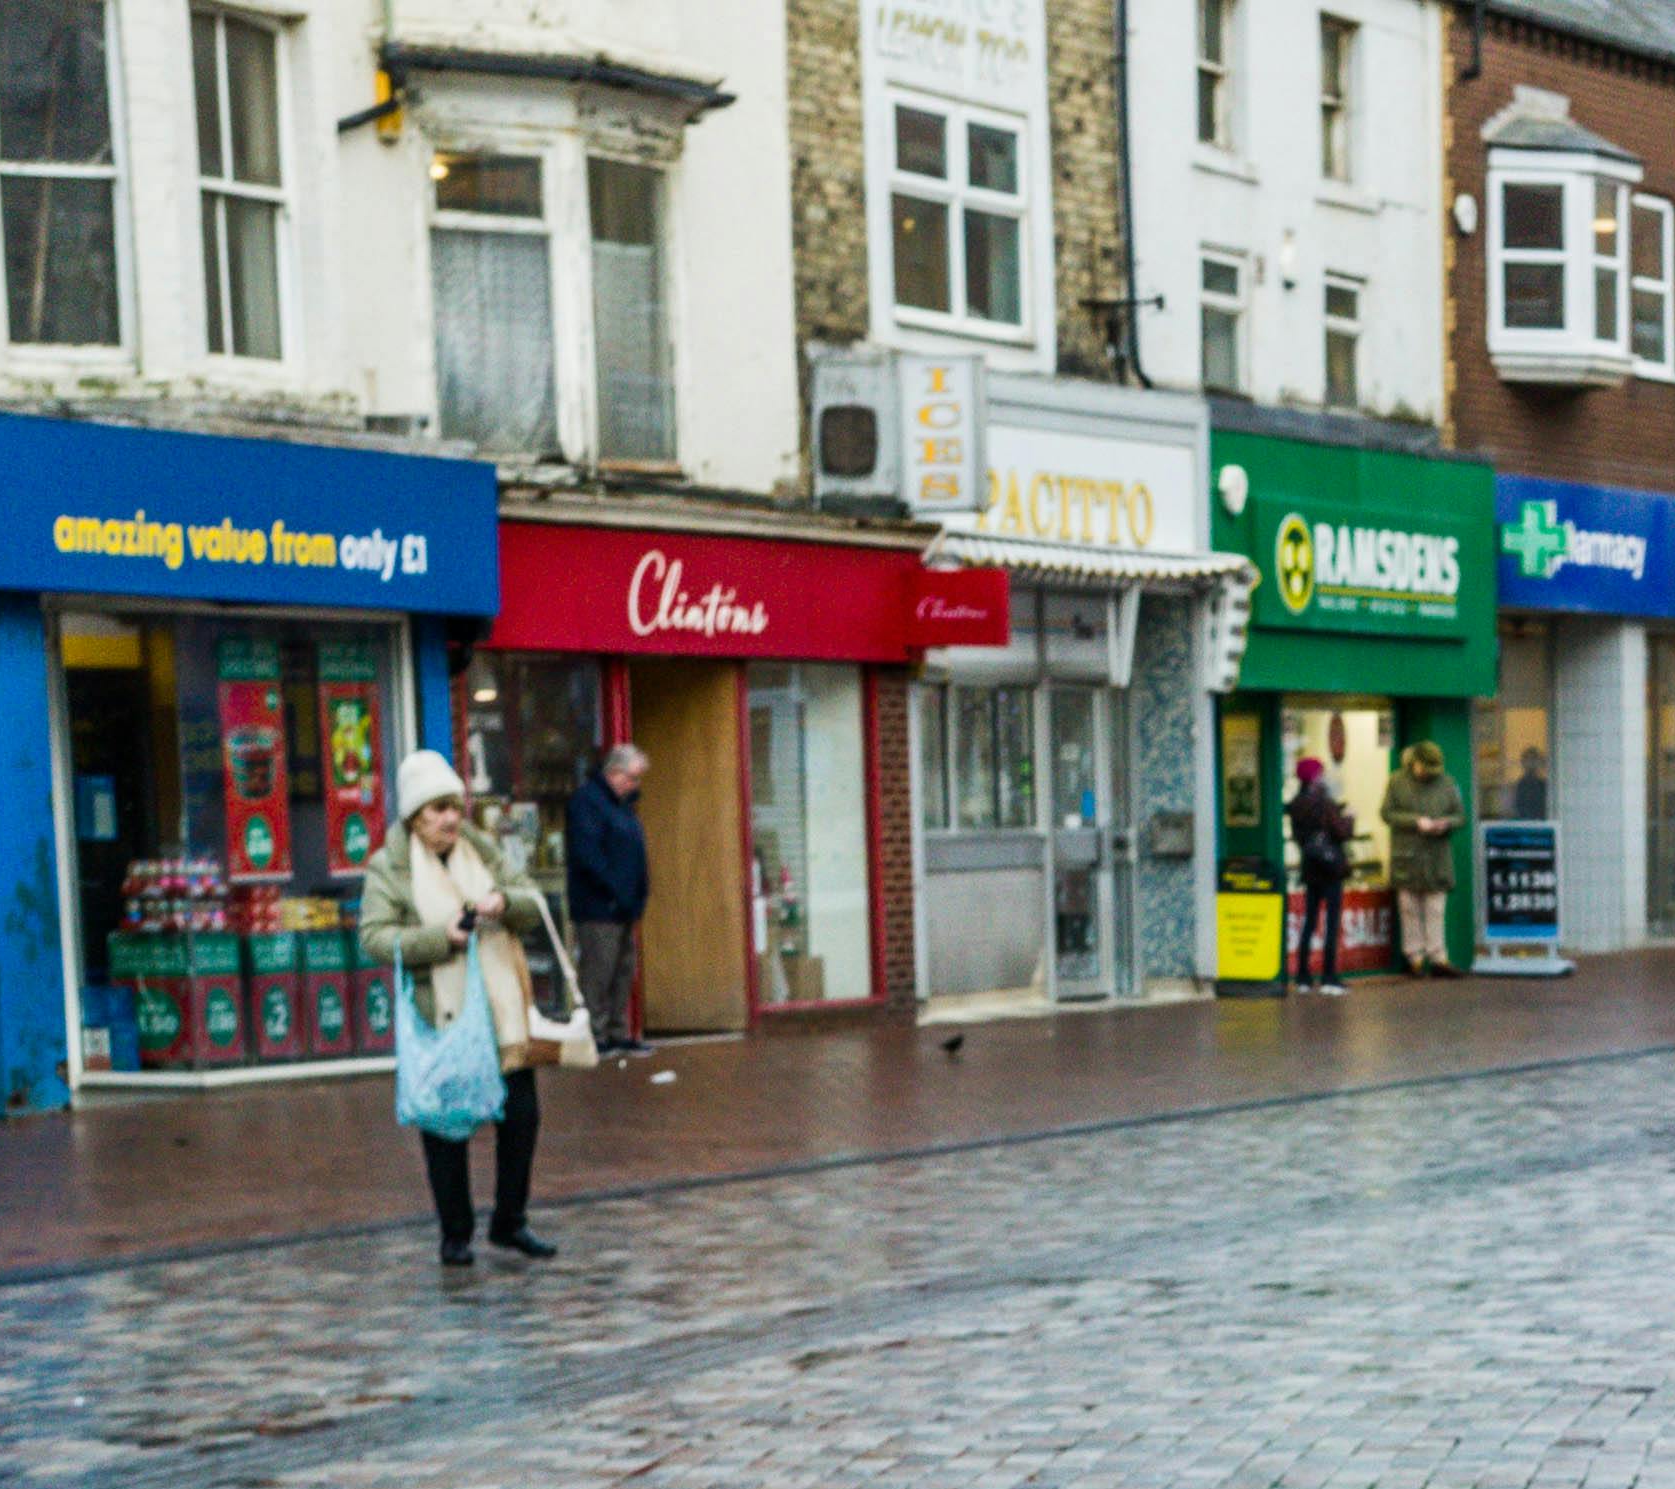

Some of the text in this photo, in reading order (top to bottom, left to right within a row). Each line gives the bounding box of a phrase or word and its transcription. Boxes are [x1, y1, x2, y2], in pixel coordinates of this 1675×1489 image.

[977, 468, 1154, 547] PACITTO
[54, 510, 183, 569] amazing
[190, 517, 265, 565] value
[272, 520, 336, 567] from
[340, 529, 397, 582] only
[1314, 523, 1459, 595] RAMSDENS
[627, 550, 768, 637] Clintons
